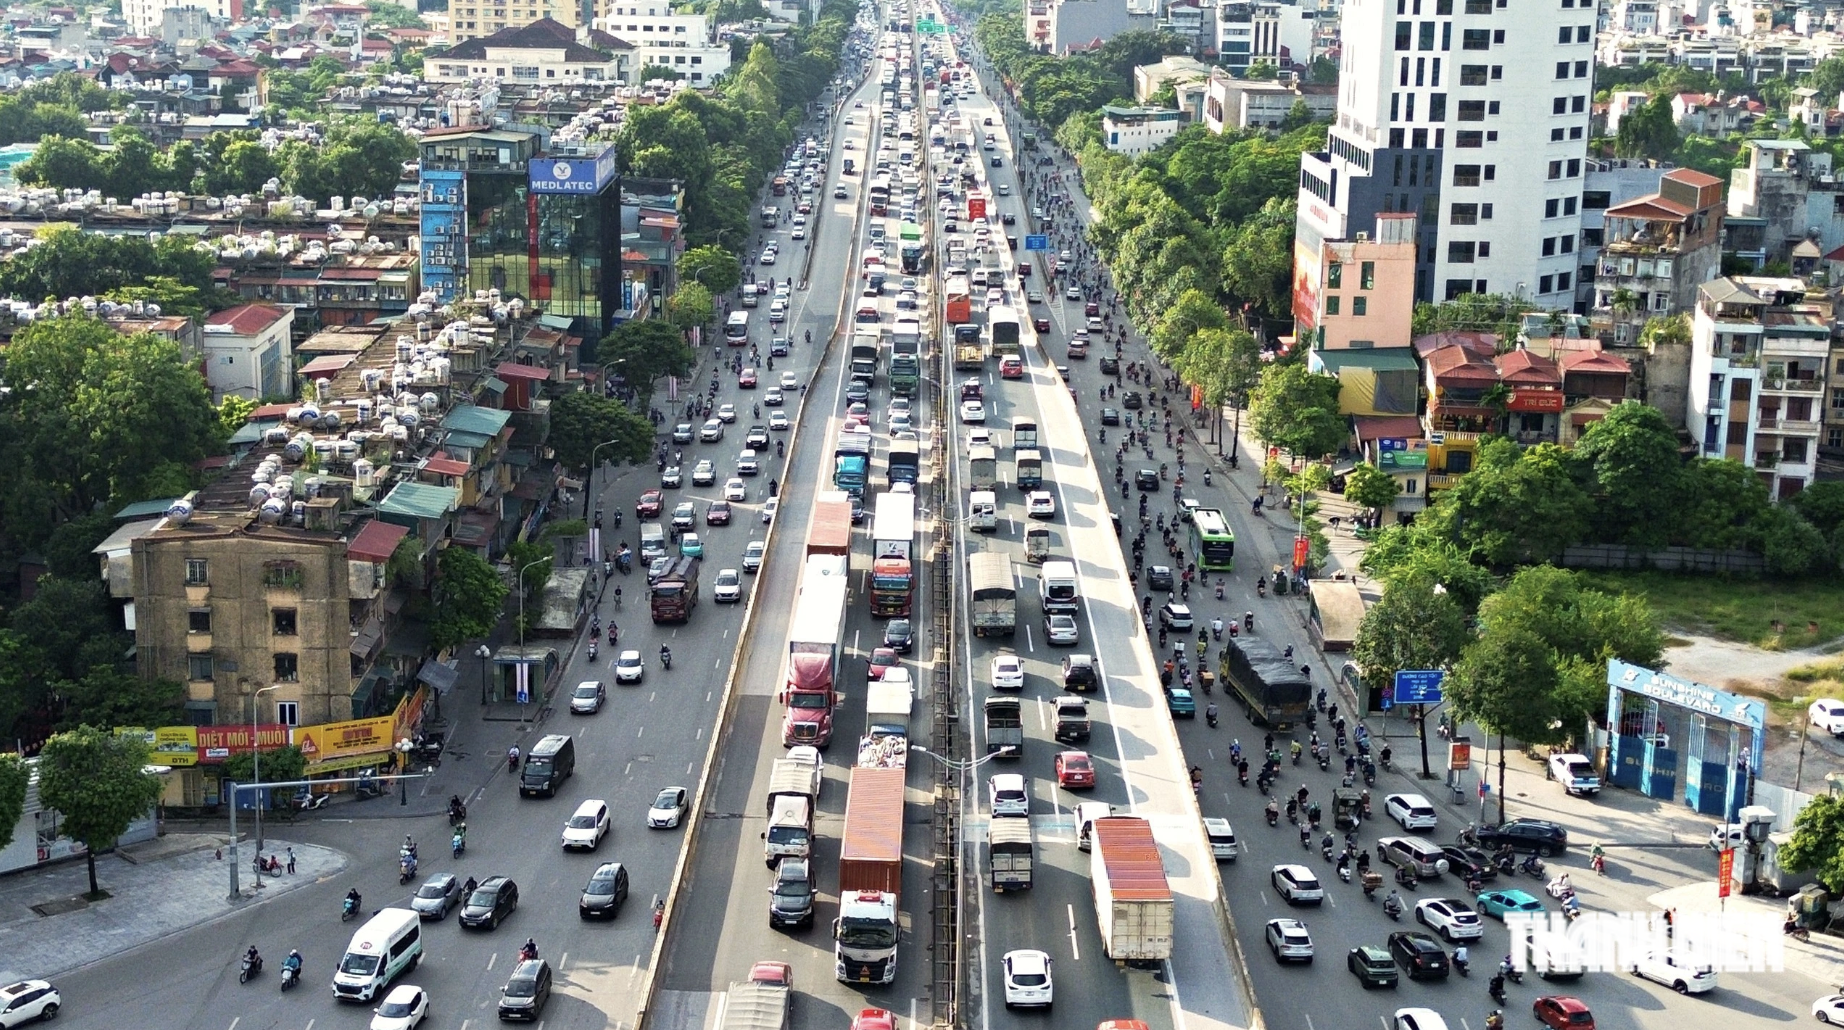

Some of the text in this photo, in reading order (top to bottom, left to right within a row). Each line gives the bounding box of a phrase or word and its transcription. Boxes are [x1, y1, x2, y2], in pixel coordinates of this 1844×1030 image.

[531, 181, 593, 190] MEDLATEC
[1643, 684, 1722, 714] BOULEVARD
[1650, 675, 1716, 702] SUNSHINE
[199, 730, 224, 749] DIỆT
[226, 727, 249, 746] MỐI
